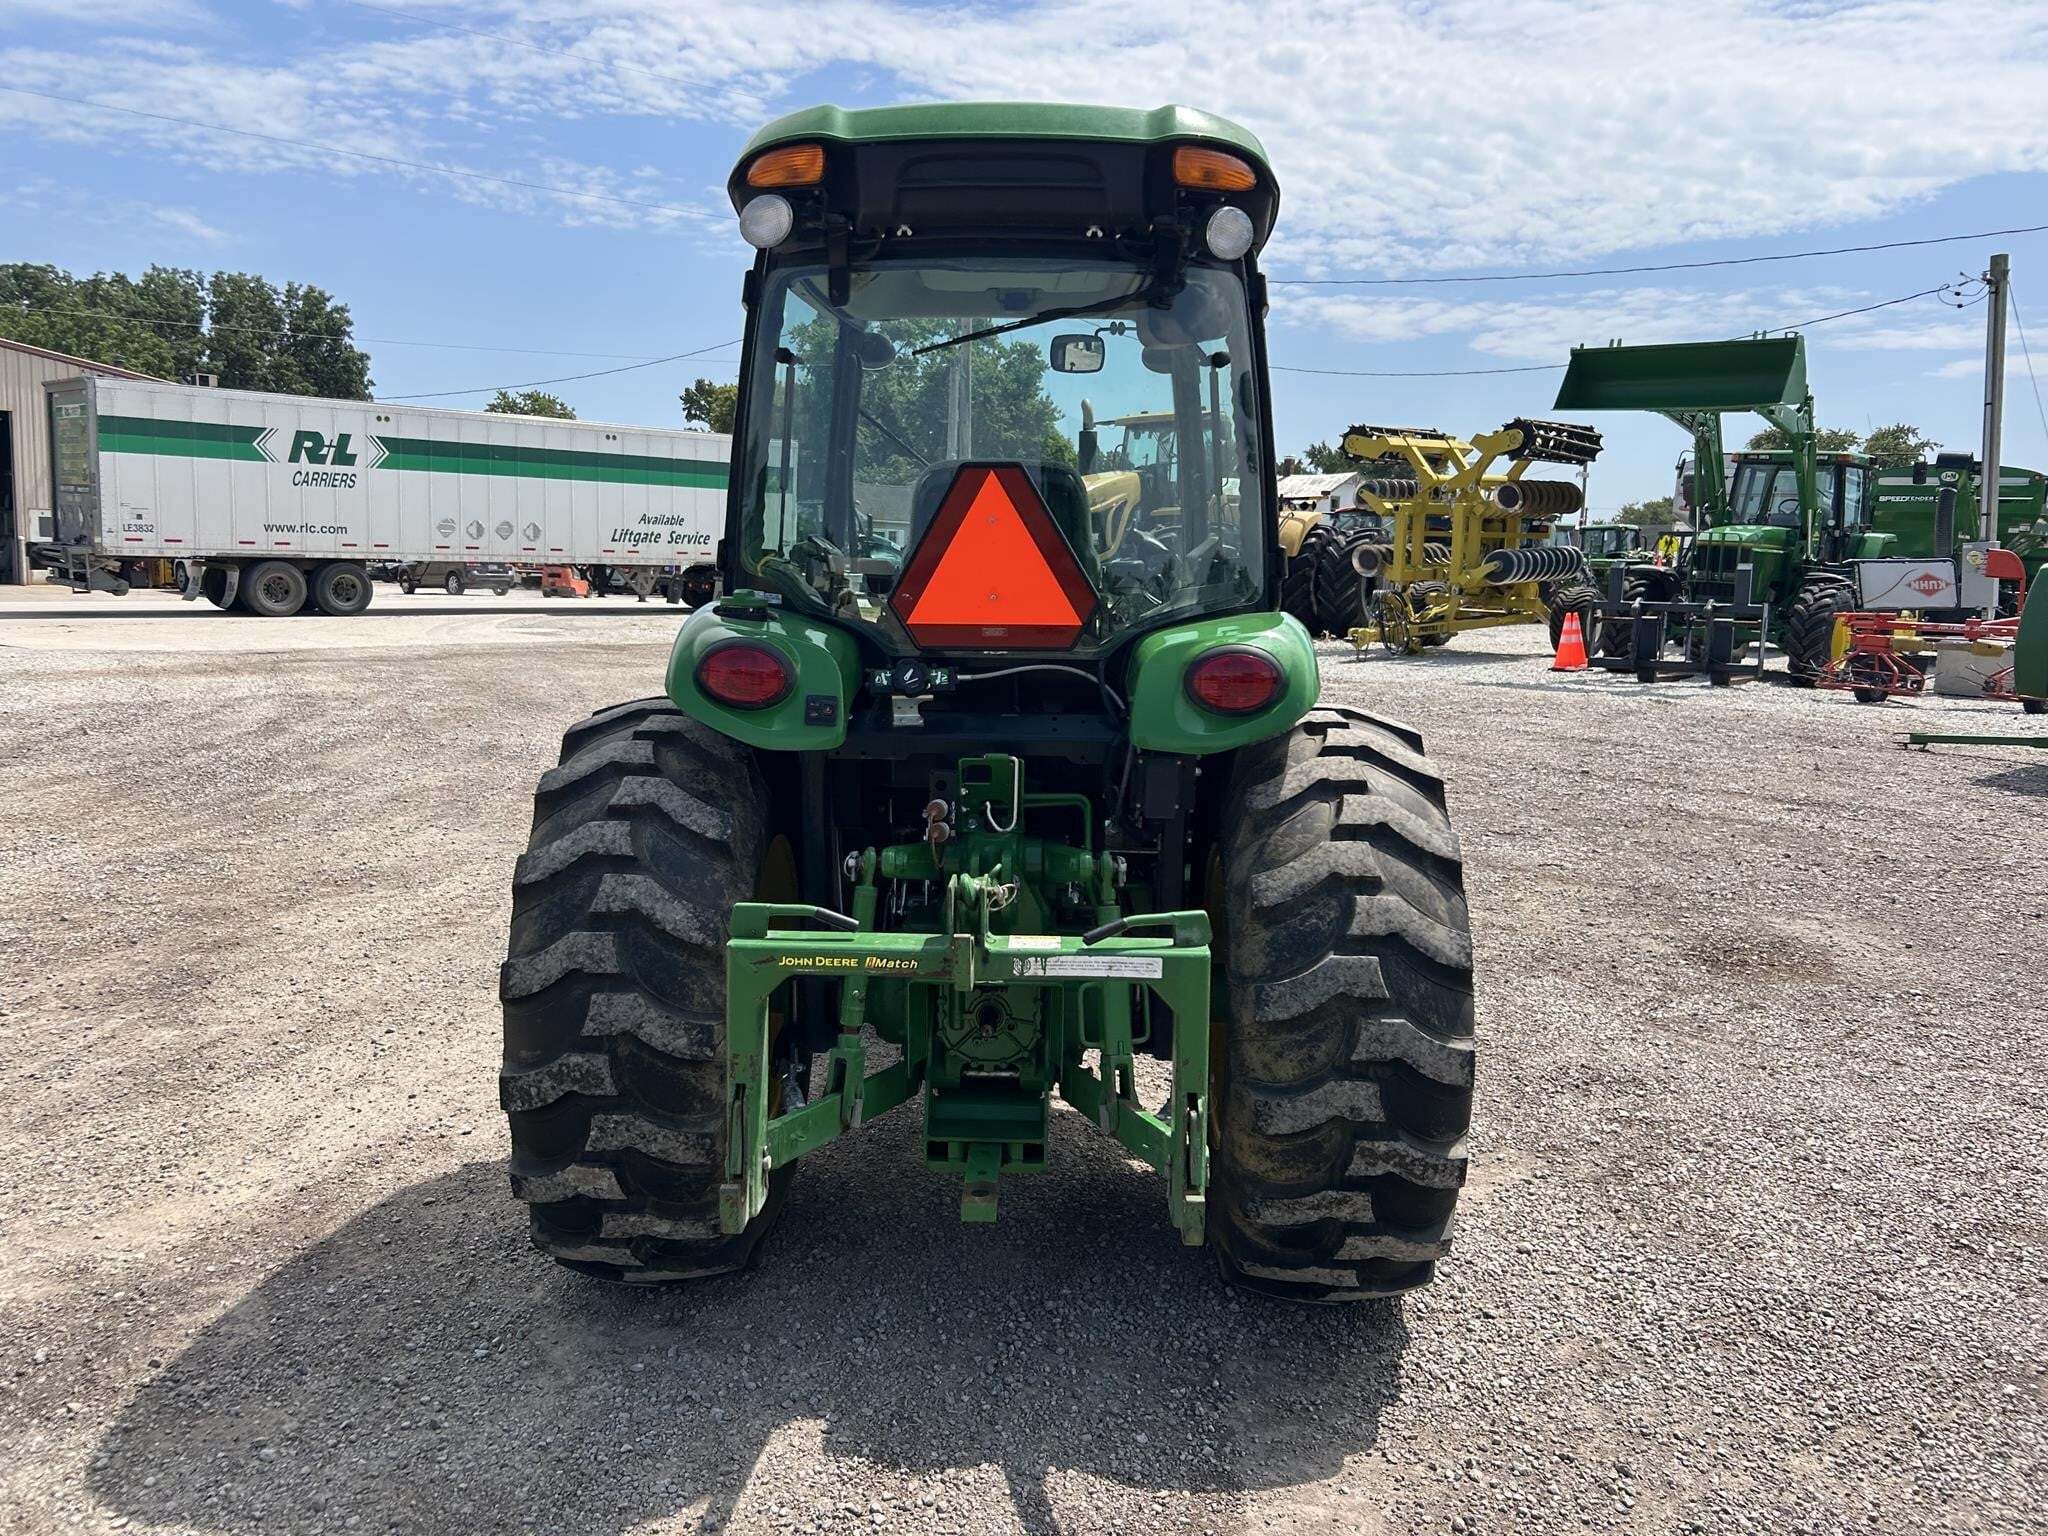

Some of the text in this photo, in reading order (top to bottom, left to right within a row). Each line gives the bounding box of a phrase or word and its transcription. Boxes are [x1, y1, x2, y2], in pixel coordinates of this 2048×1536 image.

[292, 470, 357, 489] CARRIERS
[638, 513, 685, 526] Available
[122, 523, 155, 533] LE3832
[263, 523, 348, 534] www.rlc.com
[610, 528, 711, 547] Liftgate Service
[778, 956, 813, 967] JOHN
[815, 956, 859, 967] DEERE
